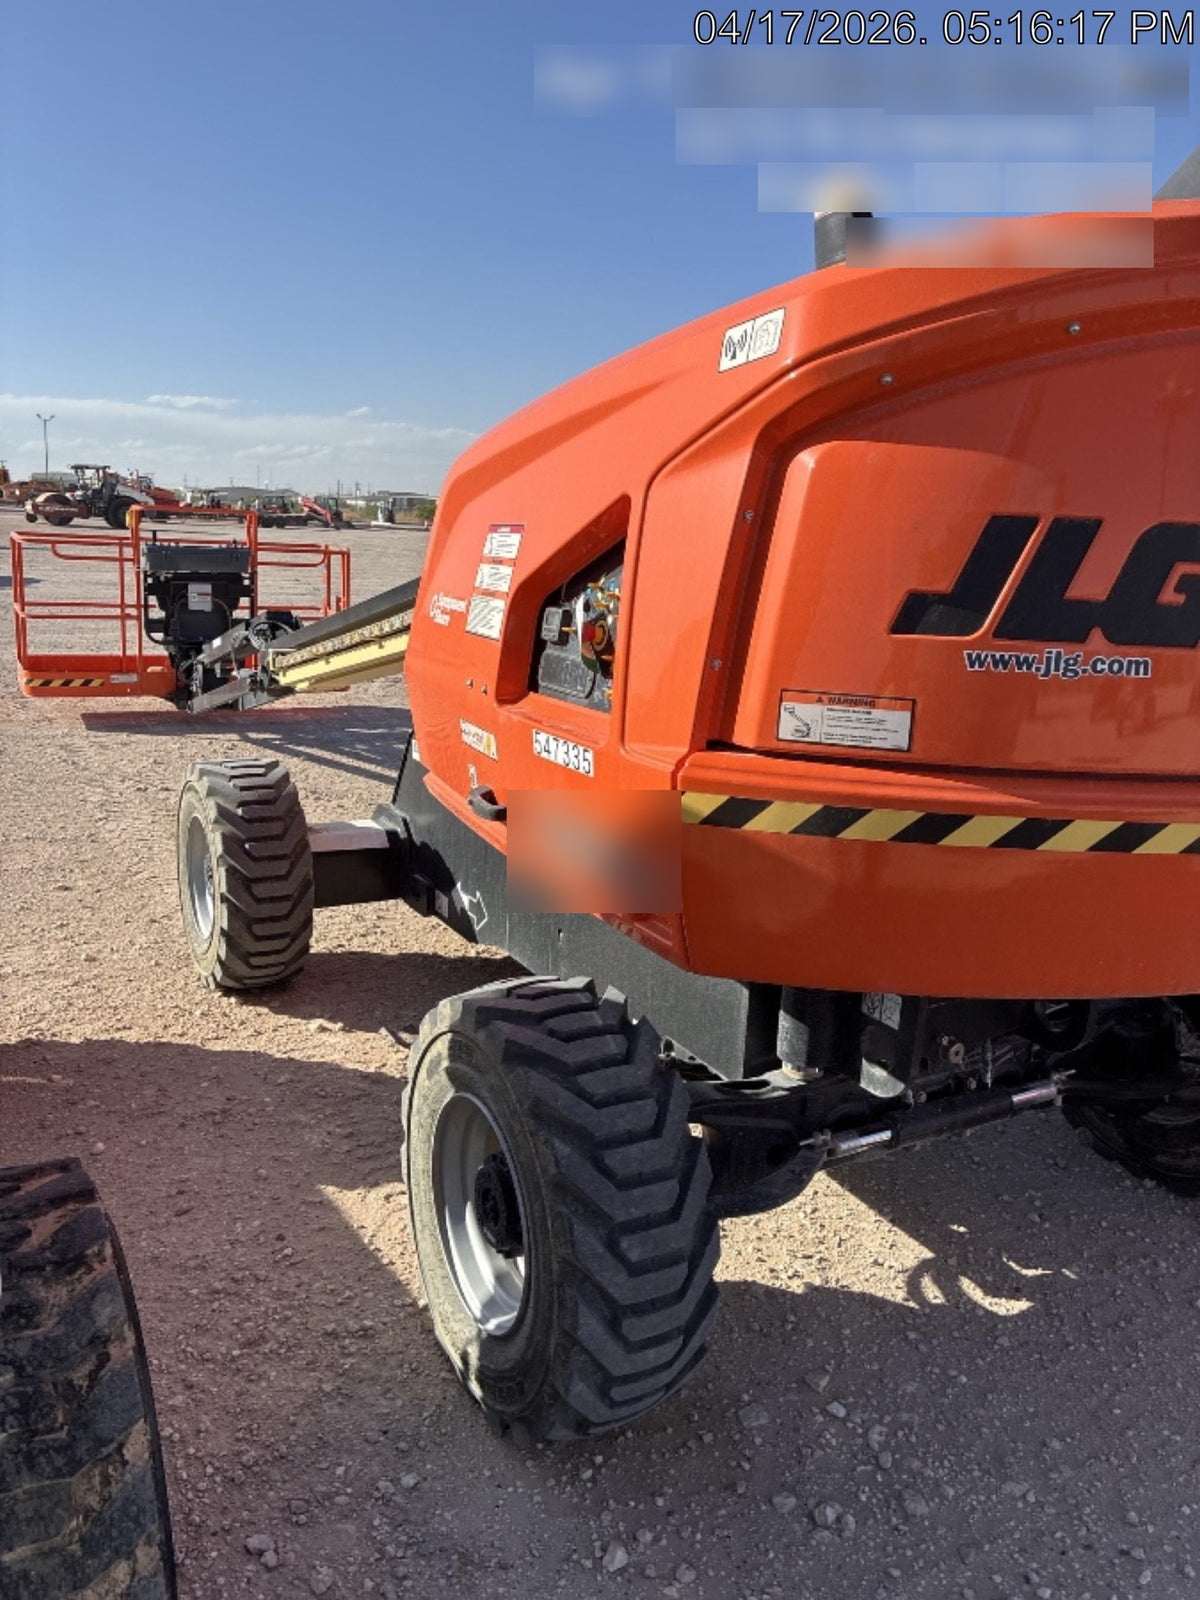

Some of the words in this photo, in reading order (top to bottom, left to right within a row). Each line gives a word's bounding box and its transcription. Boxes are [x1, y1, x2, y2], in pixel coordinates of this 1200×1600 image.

[887, 514, 1200, 648] JLG
[964, 649, 1152, 679] www.jlg.com
[827, 696, 877, 708] WARNING
[534, 729, 592, 775] 547335
